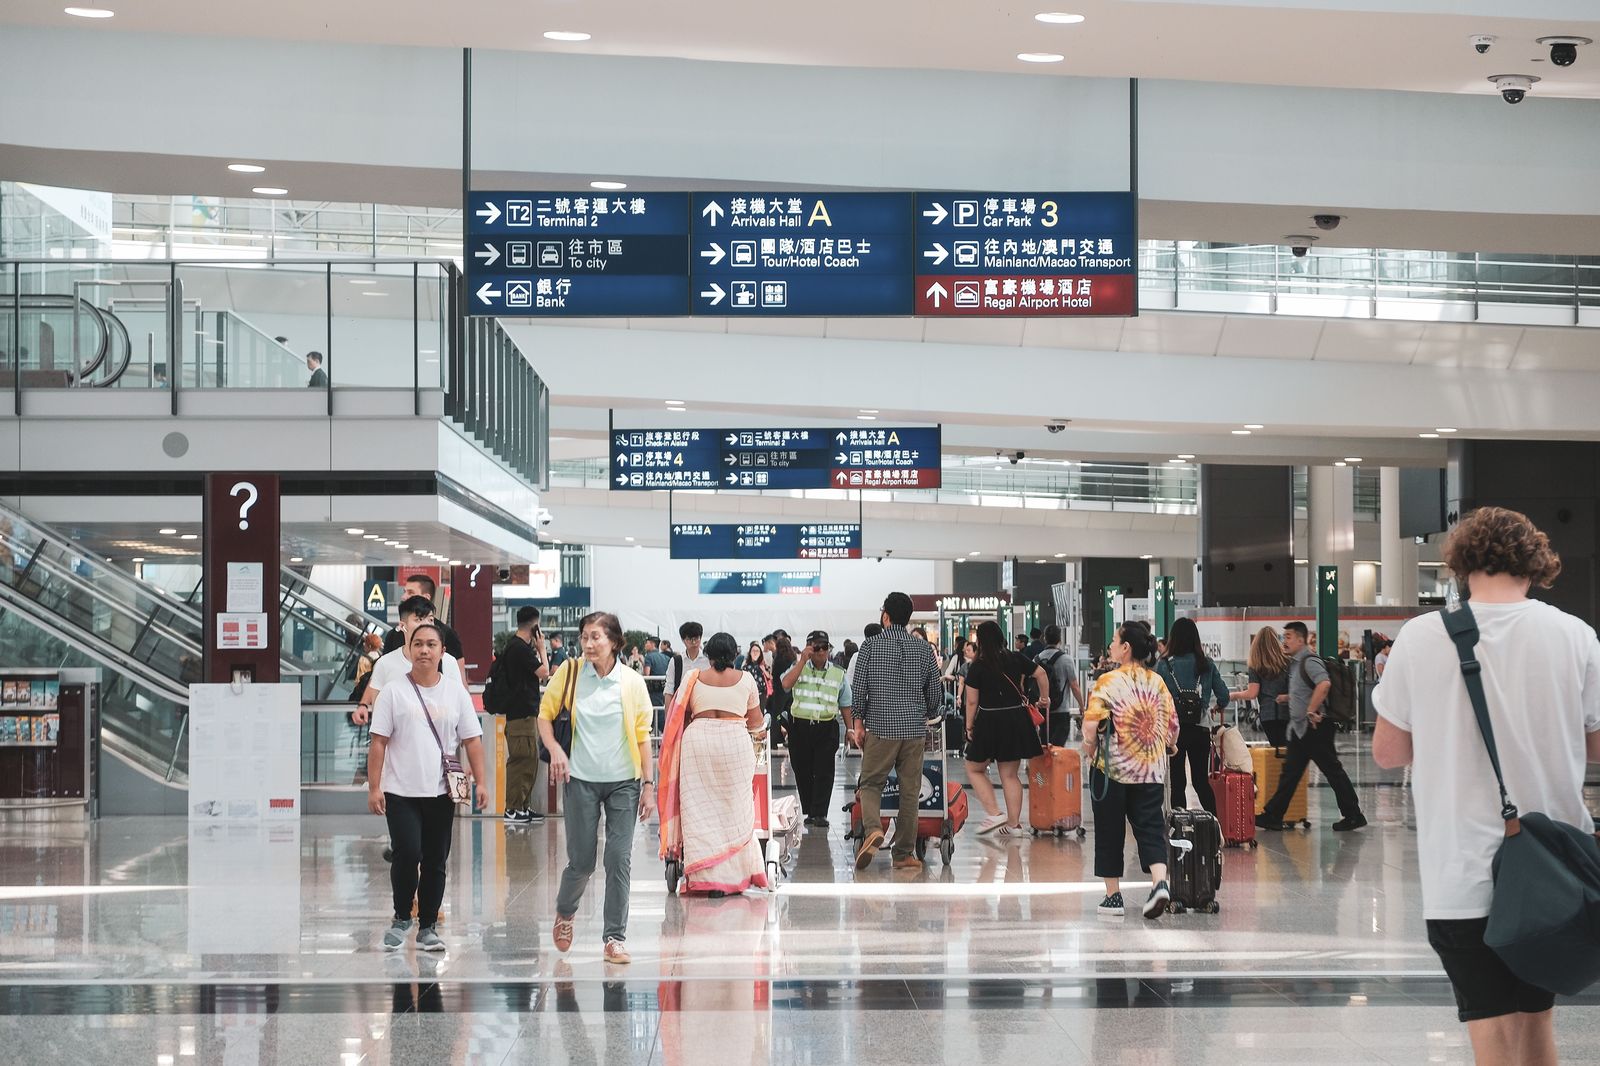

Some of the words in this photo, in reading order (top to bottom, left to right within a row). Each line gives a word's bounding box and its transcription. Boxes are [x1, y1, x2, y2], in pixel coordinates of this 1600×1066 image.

[537, 198, 646, 214] 二號客運大樓
[731, 198, 803, 215] 接機大堂
[984, 198, 1036, 215] 停車場
[509, 205, 530, 222] T2
[807, 200, 832, 227] A
[958, 204, 975, 224] P
[1040, 200, 1058, 228] 3
[536, 215, 587, 227] Terminal
[590, 215, 598, 226] 2
[731, 215, 776, 227] Arrivals
[779, 215, 801, 227] Hall
[983, 215, 1002, 227] Car
[1006, 215, 1032, 227] Park
[568, 239, 623, 256] 往市區
[761, 238, 871, 255] 團隊/酒店巴士
[568, 257, 582, 268] To
[586, 257, 608, 270] city
[761, 255, 820, 268] Tour/Hotel
[824, 256, 860, 268] Coach
[984, 256, 1076, 268] Mainland/Macao
[1078, 256, 1131, 270] Transport
[536, 278, 572, 296] 銀行
[984, 278, 1092, 296] 富豪機場酒店
[536, 295, 566, 308] Bank
[984, 296, 1016, 310] Regal
[1018, 296, 1058, 310] Airport
[1062, 296, 1092, 308] Hotel
[742, 435, 752, 444] T2
[887, 431, 900, 446] A
[633, 454, 642, 466] P
[674, 452, 683, 466] 4
[704, 526, 711, 535] A
[961, 598, 967, 610] A
[1201, 643, 1222, 657] TCHEN
